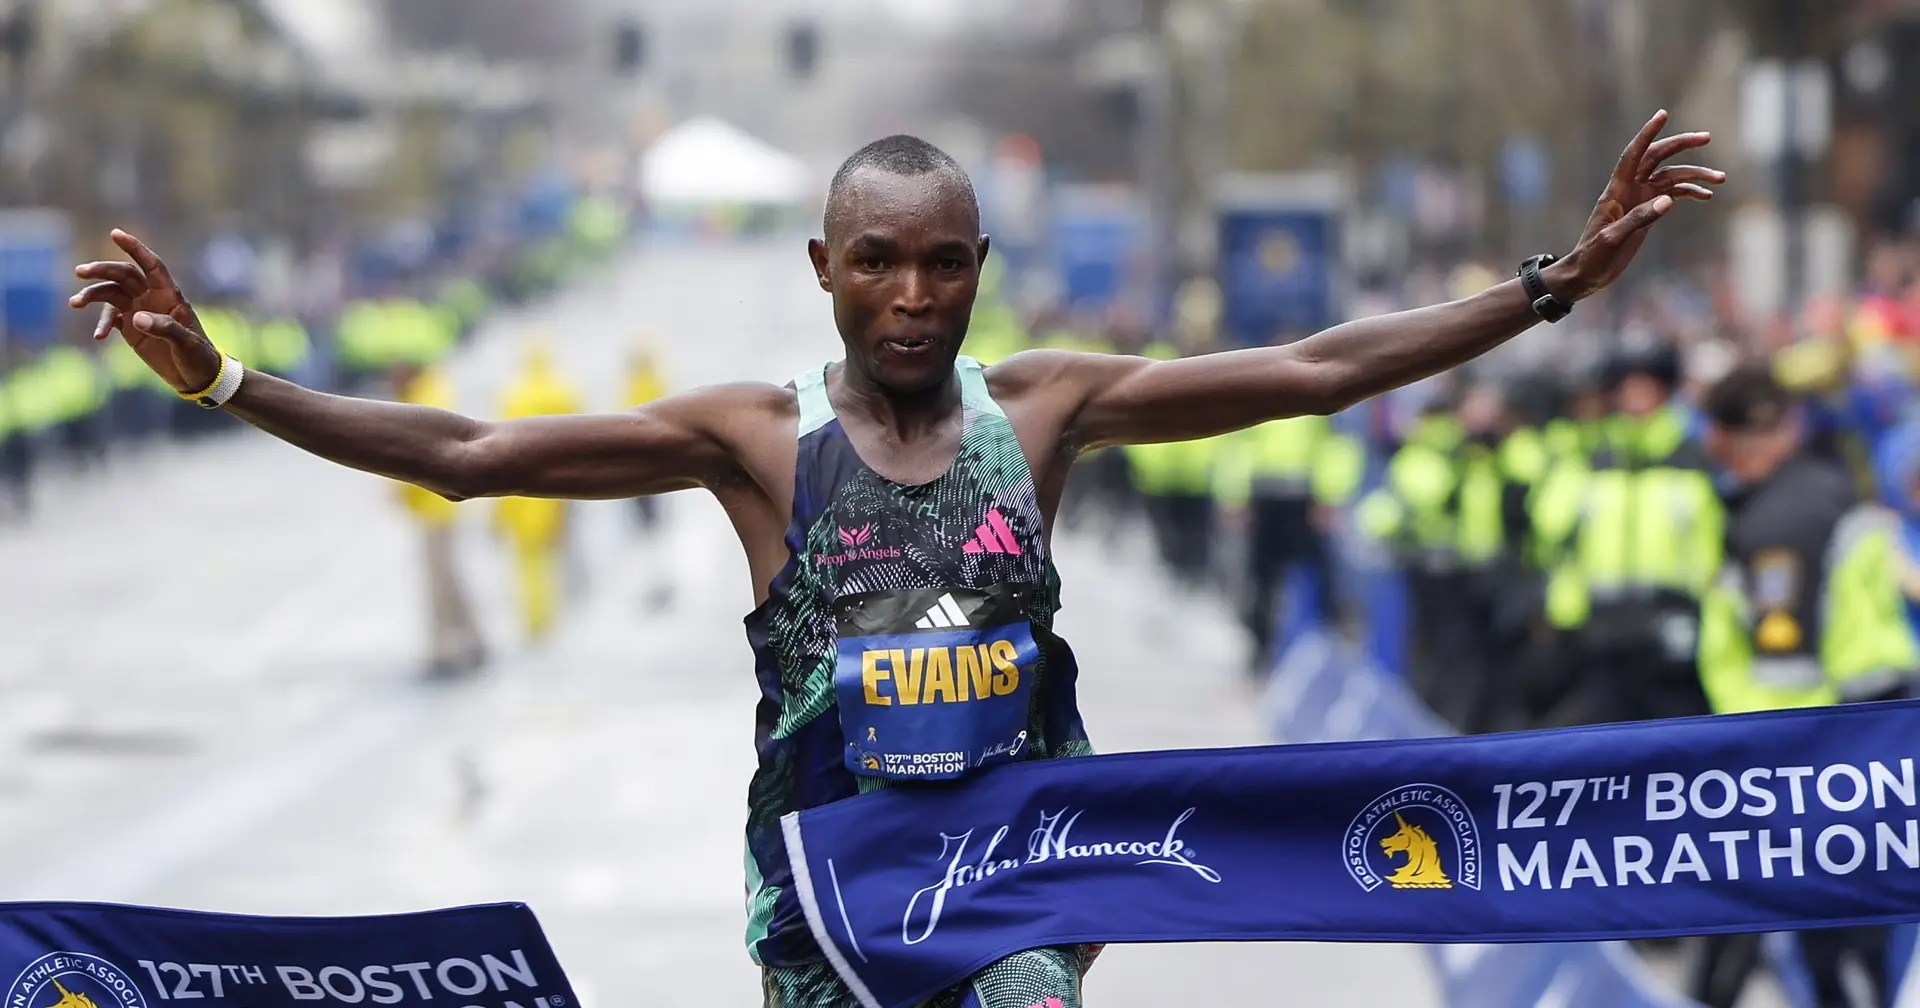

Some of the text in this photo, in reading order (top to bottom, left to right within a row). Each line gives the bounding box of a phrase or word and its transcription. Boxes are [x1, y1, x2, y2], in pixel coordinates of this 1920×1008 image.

[857, 545, 901, 560] Angels
[862, 640, 1020, 706] EVANS
[884, 753, 911, 764] 127TH
[913, 751, 964, 764] BOSTON
[886, 762, 965, 775] MARATHON
[1492, 758, 1917, 830] 127TH BOSTON
[1350, 790, 1476, 885] BOSTON ATHLETIC ASSOCIATION
[1497, 819, 1920, 892] MARATHON
[902, 825, 1018, 946] John
[22, 957, 84, 994] ATHLETIC
[137, 949, 539, 1005] 127TH BOSTON
